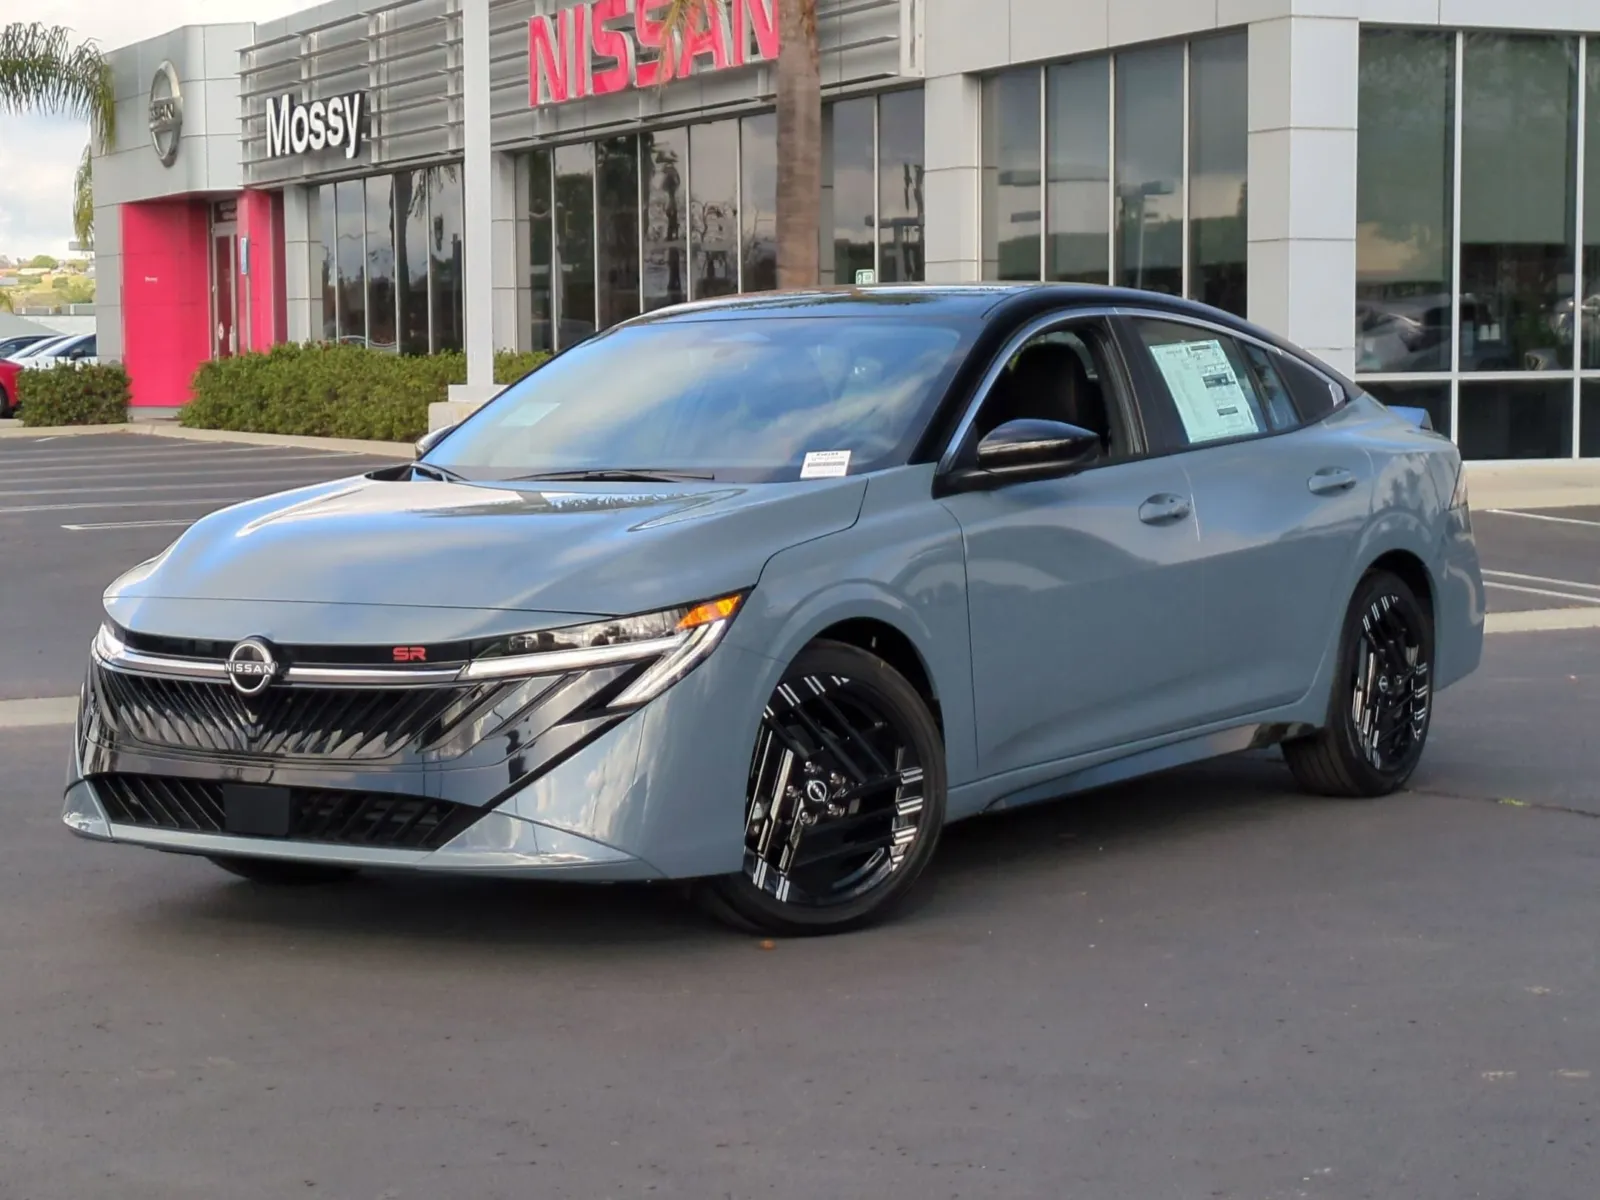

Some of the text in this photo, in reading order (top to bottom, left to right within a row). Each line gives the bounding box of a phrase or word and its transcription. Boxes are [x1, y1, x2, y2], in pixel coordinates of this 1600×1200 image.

[528, 0, 779, 108] NISSAN
[393, 646, 426, 662] SR
[225, 662, 275, 674] NISSAN
